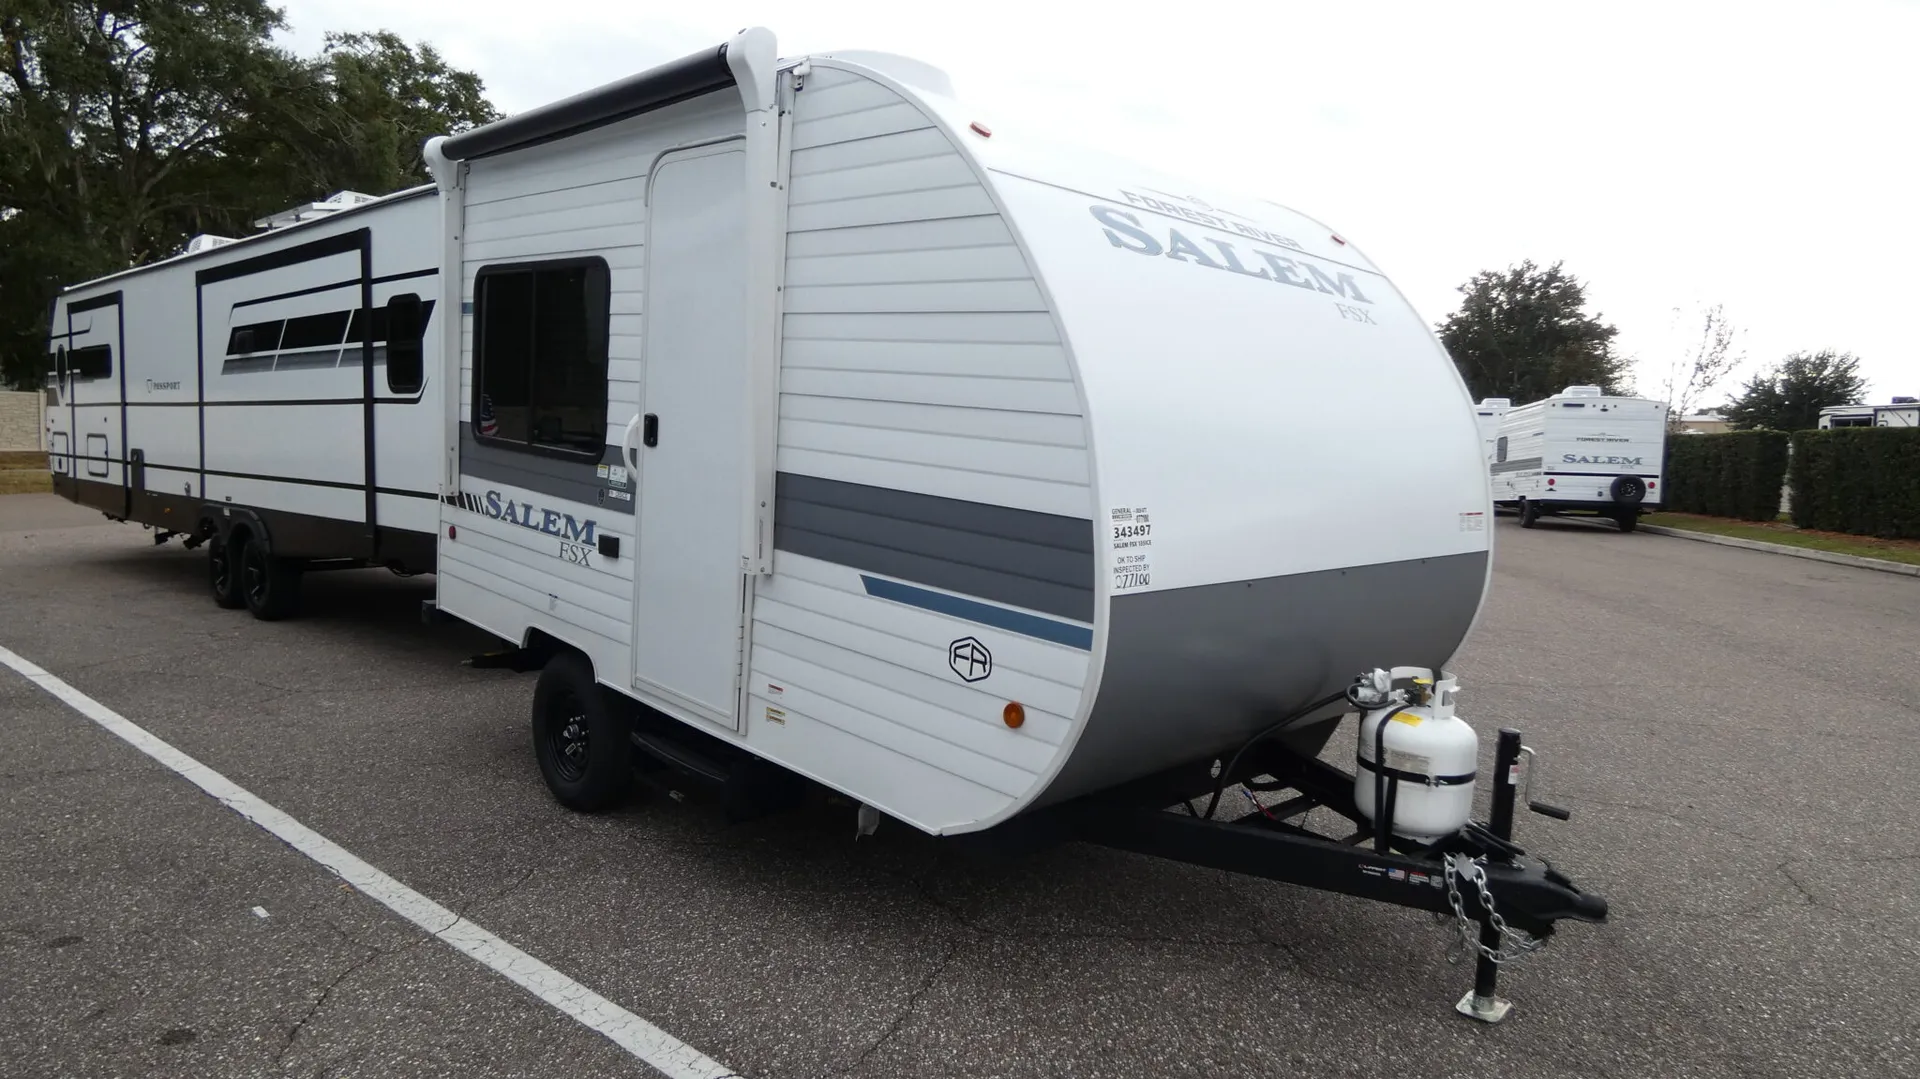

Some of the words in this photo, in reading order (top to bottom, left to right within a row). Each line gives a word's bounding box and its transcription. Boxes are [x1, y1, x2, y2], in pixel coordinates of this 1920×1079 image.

[1118, 188, 1229, 230] FOREST
[1232, 221, 1305, 251] RIVER
[1089, 204, 1375, 305] SALEM
[1333, 301, 1379, 326] FSX
[153, 381, 180, 391] PASSPORT
[1562, 453, 1643, 466] SALEM
[485, 489, 597, 547] SALEM
[1114, 524, 1151, 539] 343497
[558, 541, 593, 567] FSX
[1117, 556, 1125, 564] OK
[1126, 555, 1133, 563] TO
[1134, 554, 1146, 562] SHIP
[1113, 564, 1142, 574] INSPECTED
